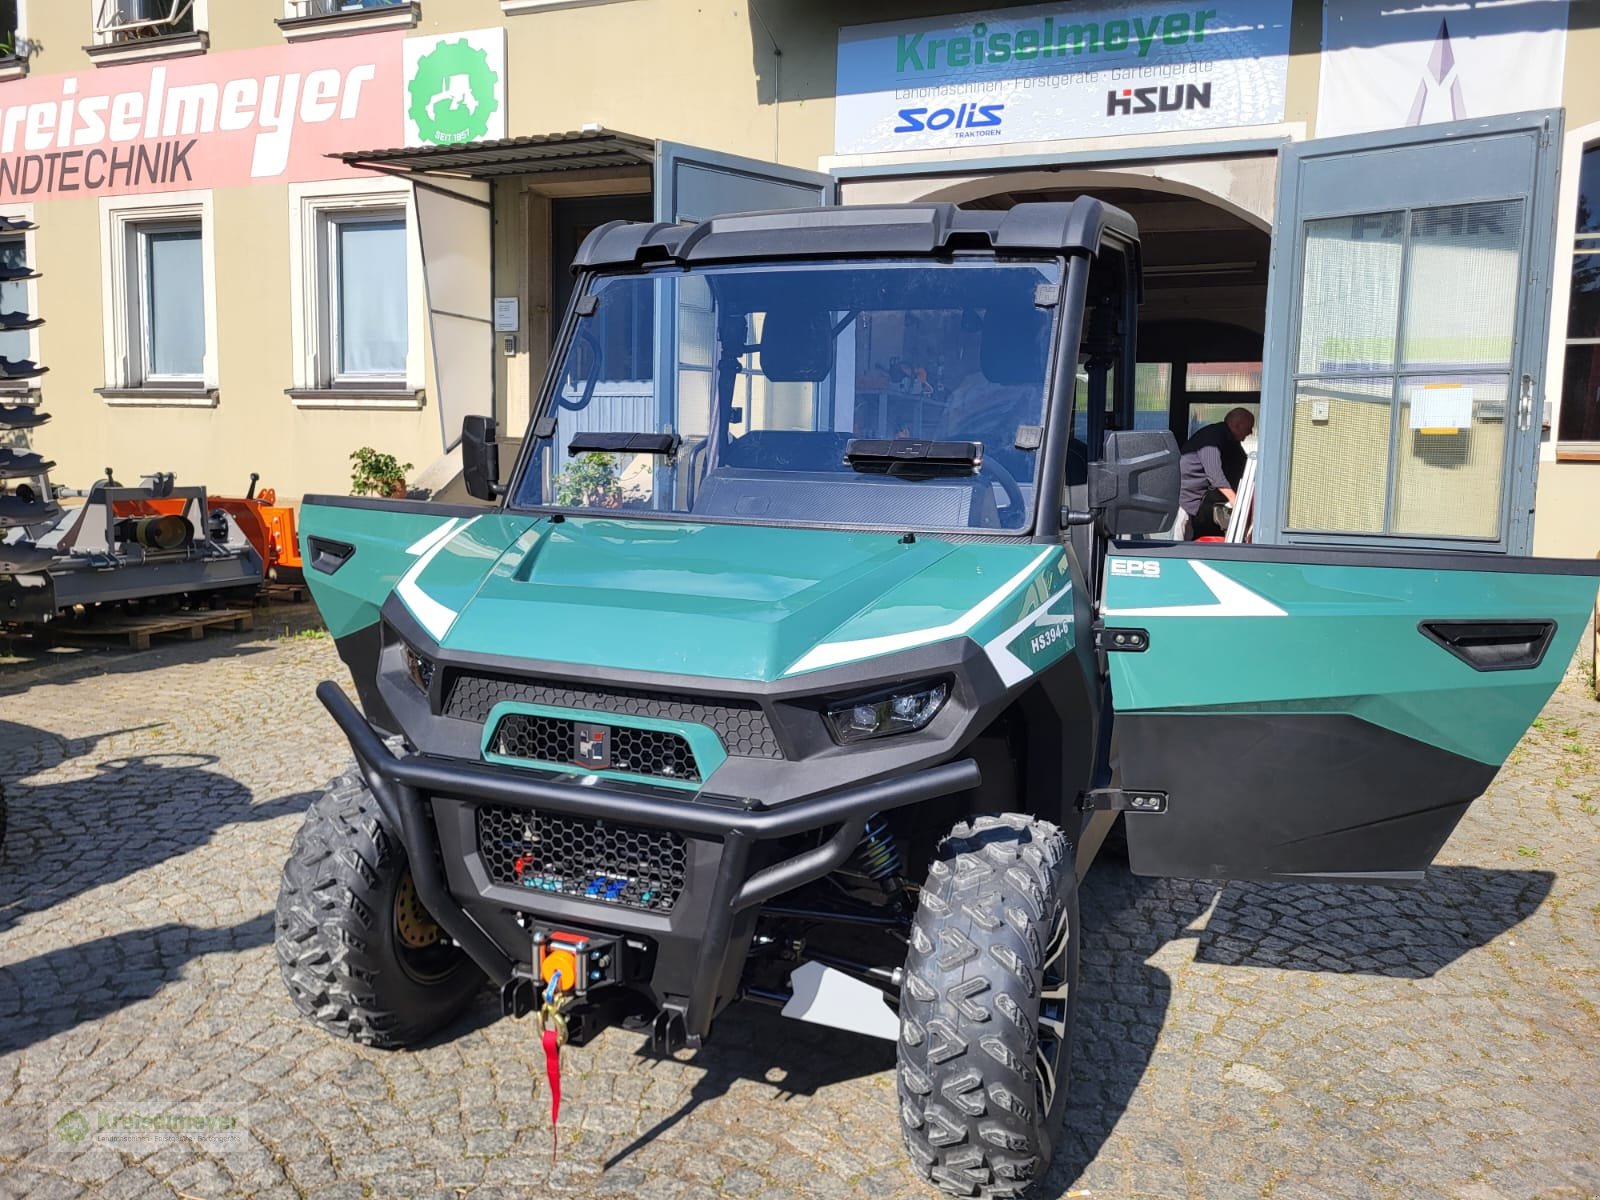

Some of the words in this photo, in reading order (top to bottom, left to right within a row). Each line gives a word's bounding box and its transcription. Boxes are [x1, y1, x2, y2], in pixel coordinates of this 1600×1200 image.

[895, 8, 1217, 74] Kreiselmeyer
[895, 78, 1003, 100] Landmaschinen
[0, 64, 376, 178] reiselmeyer
[955, 129, 1002, 138] TRAKTOREN
[1111, 559, 1160, 575] EPS
[1031, 620, 1069, 654] HS394-6
